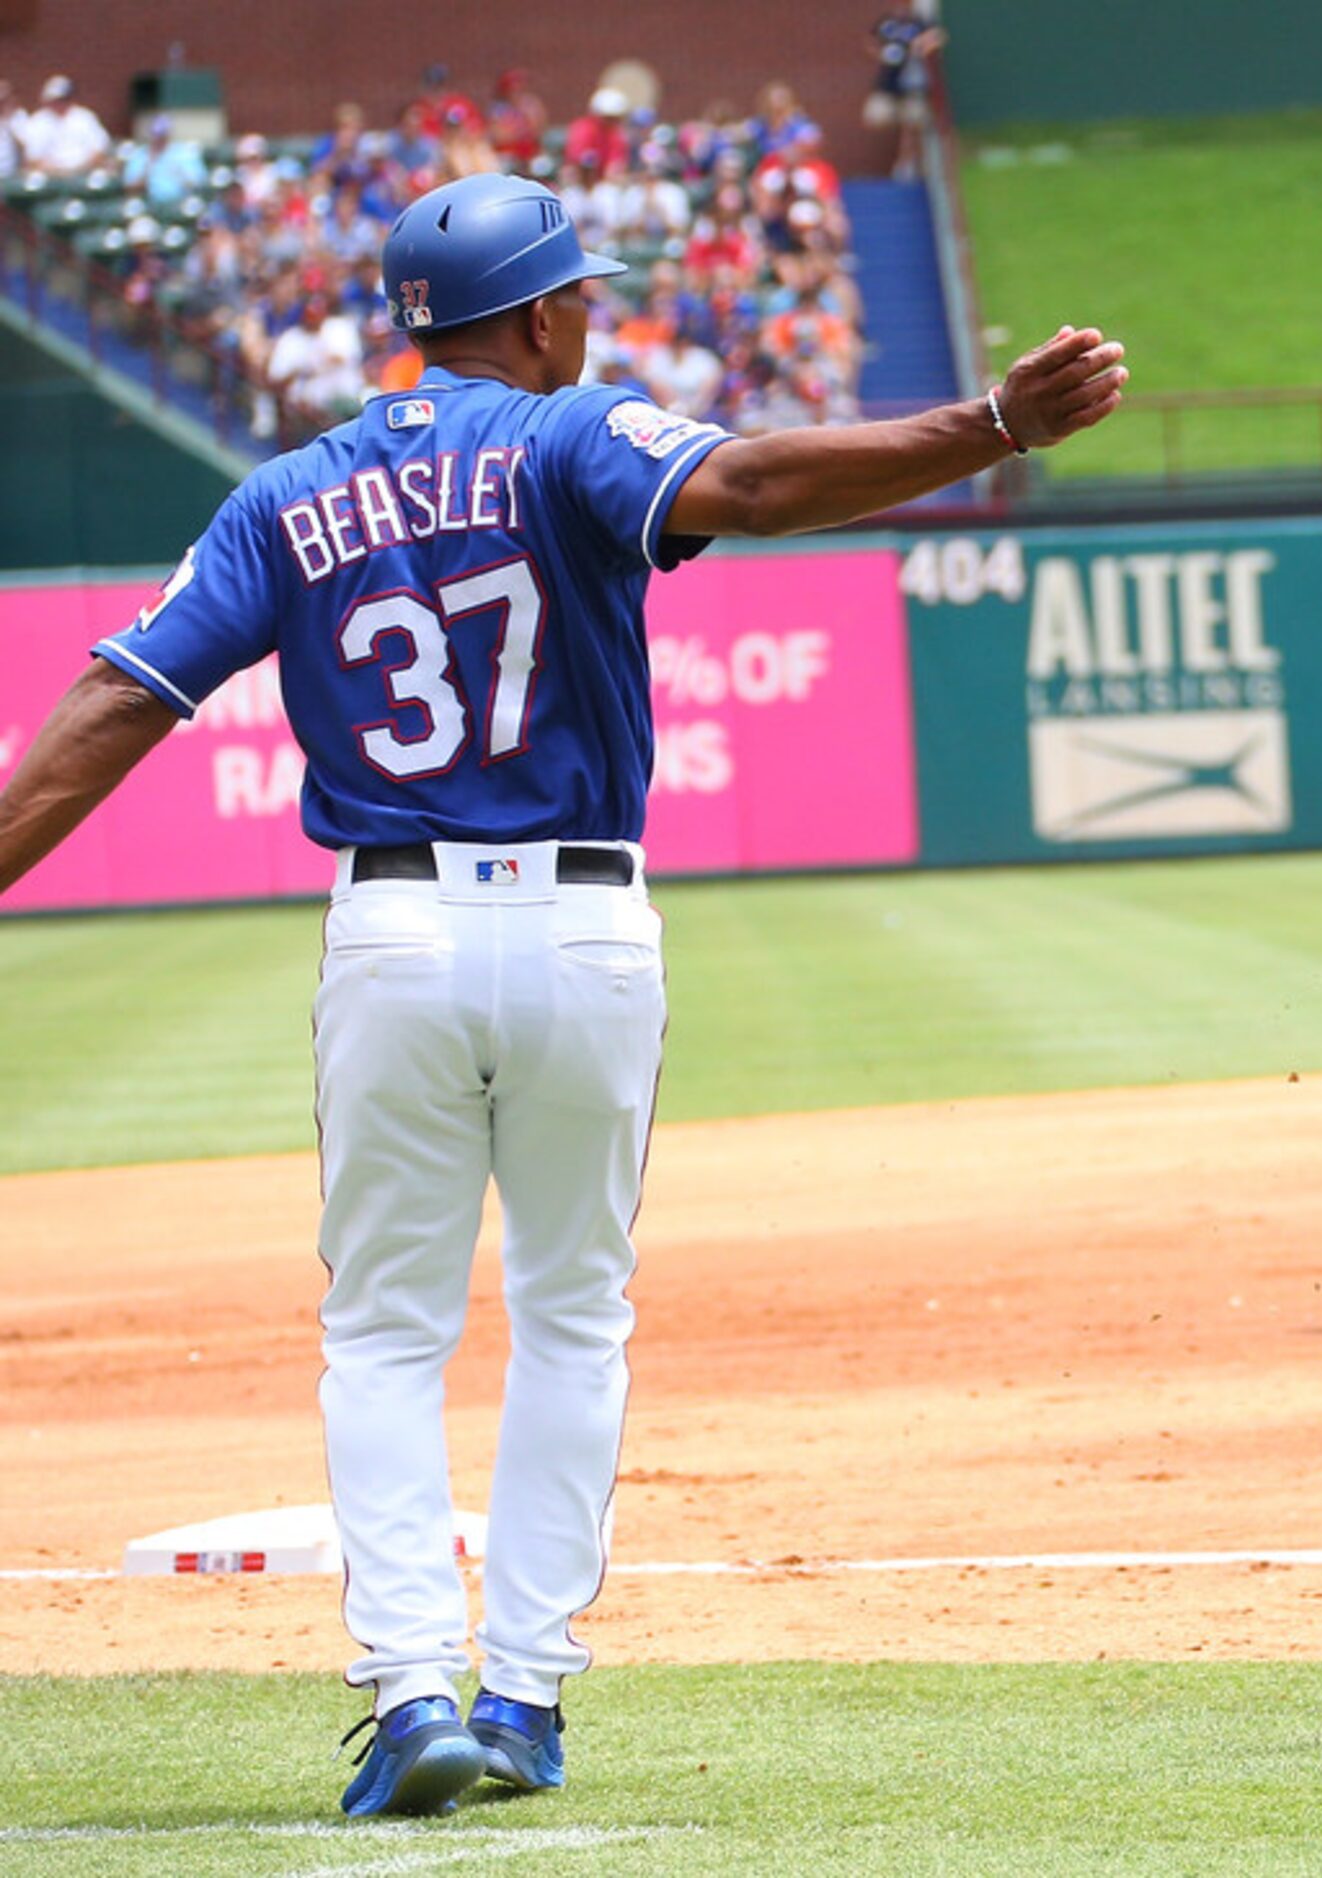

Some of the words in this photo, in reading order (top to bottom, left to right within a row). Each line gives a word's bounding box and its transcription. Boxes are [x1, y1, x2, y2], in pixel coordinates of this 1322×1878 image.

[400, 279, 430, 308] 37
[899, 537, 1027, 604] 404
[1026, 547, 1283, 679] ALTEC
[335, 552, 551, 785] 37
[731, 628, 832, 705] OF
[1025, 671, 1283, 718] LANSING
